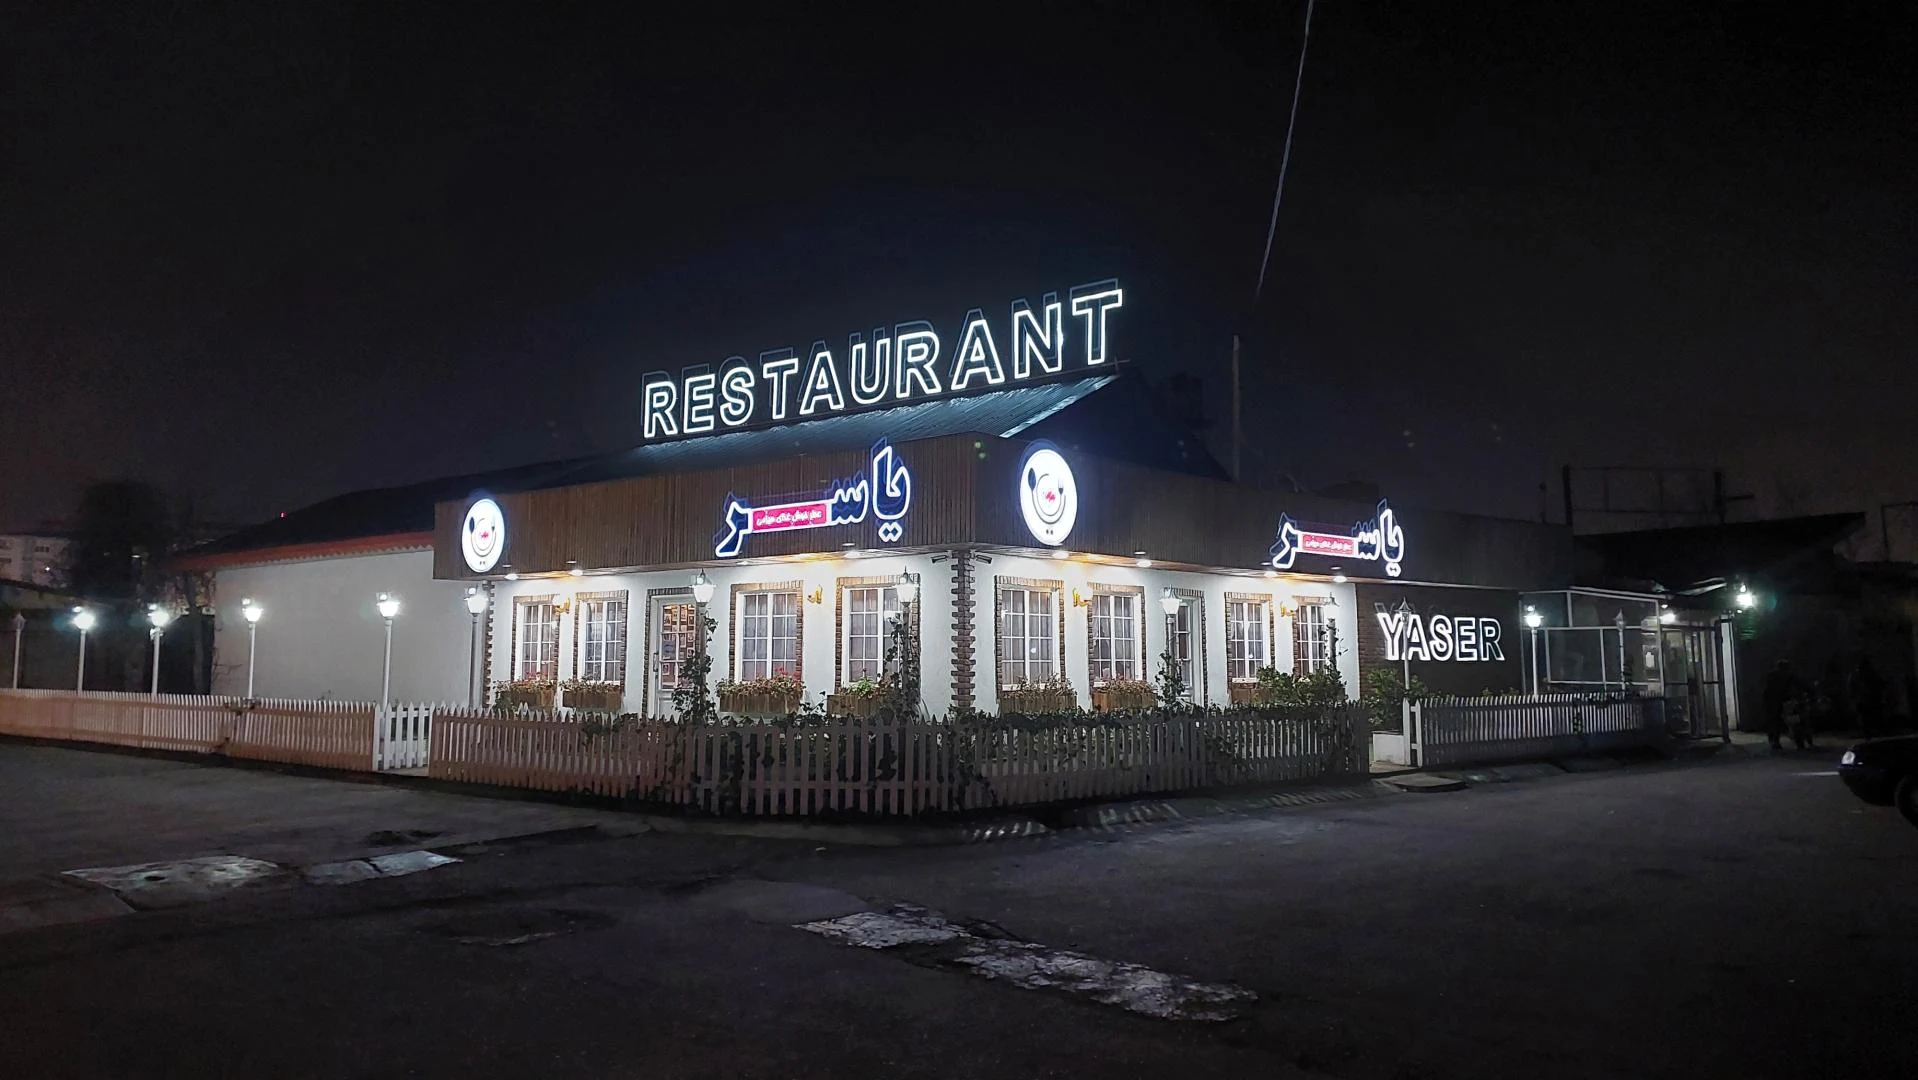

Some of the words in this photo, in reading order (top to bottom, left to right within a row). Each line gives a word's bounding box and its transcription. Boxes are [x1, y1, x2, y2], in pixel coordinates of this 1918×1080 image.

[642, 288, 1124, 439] RESTAURANT
[714, 444, 912, 558] یاسر
[1272, 508, 1405, 578] یاسر
[1375, 611, 1506, 662] YASER
